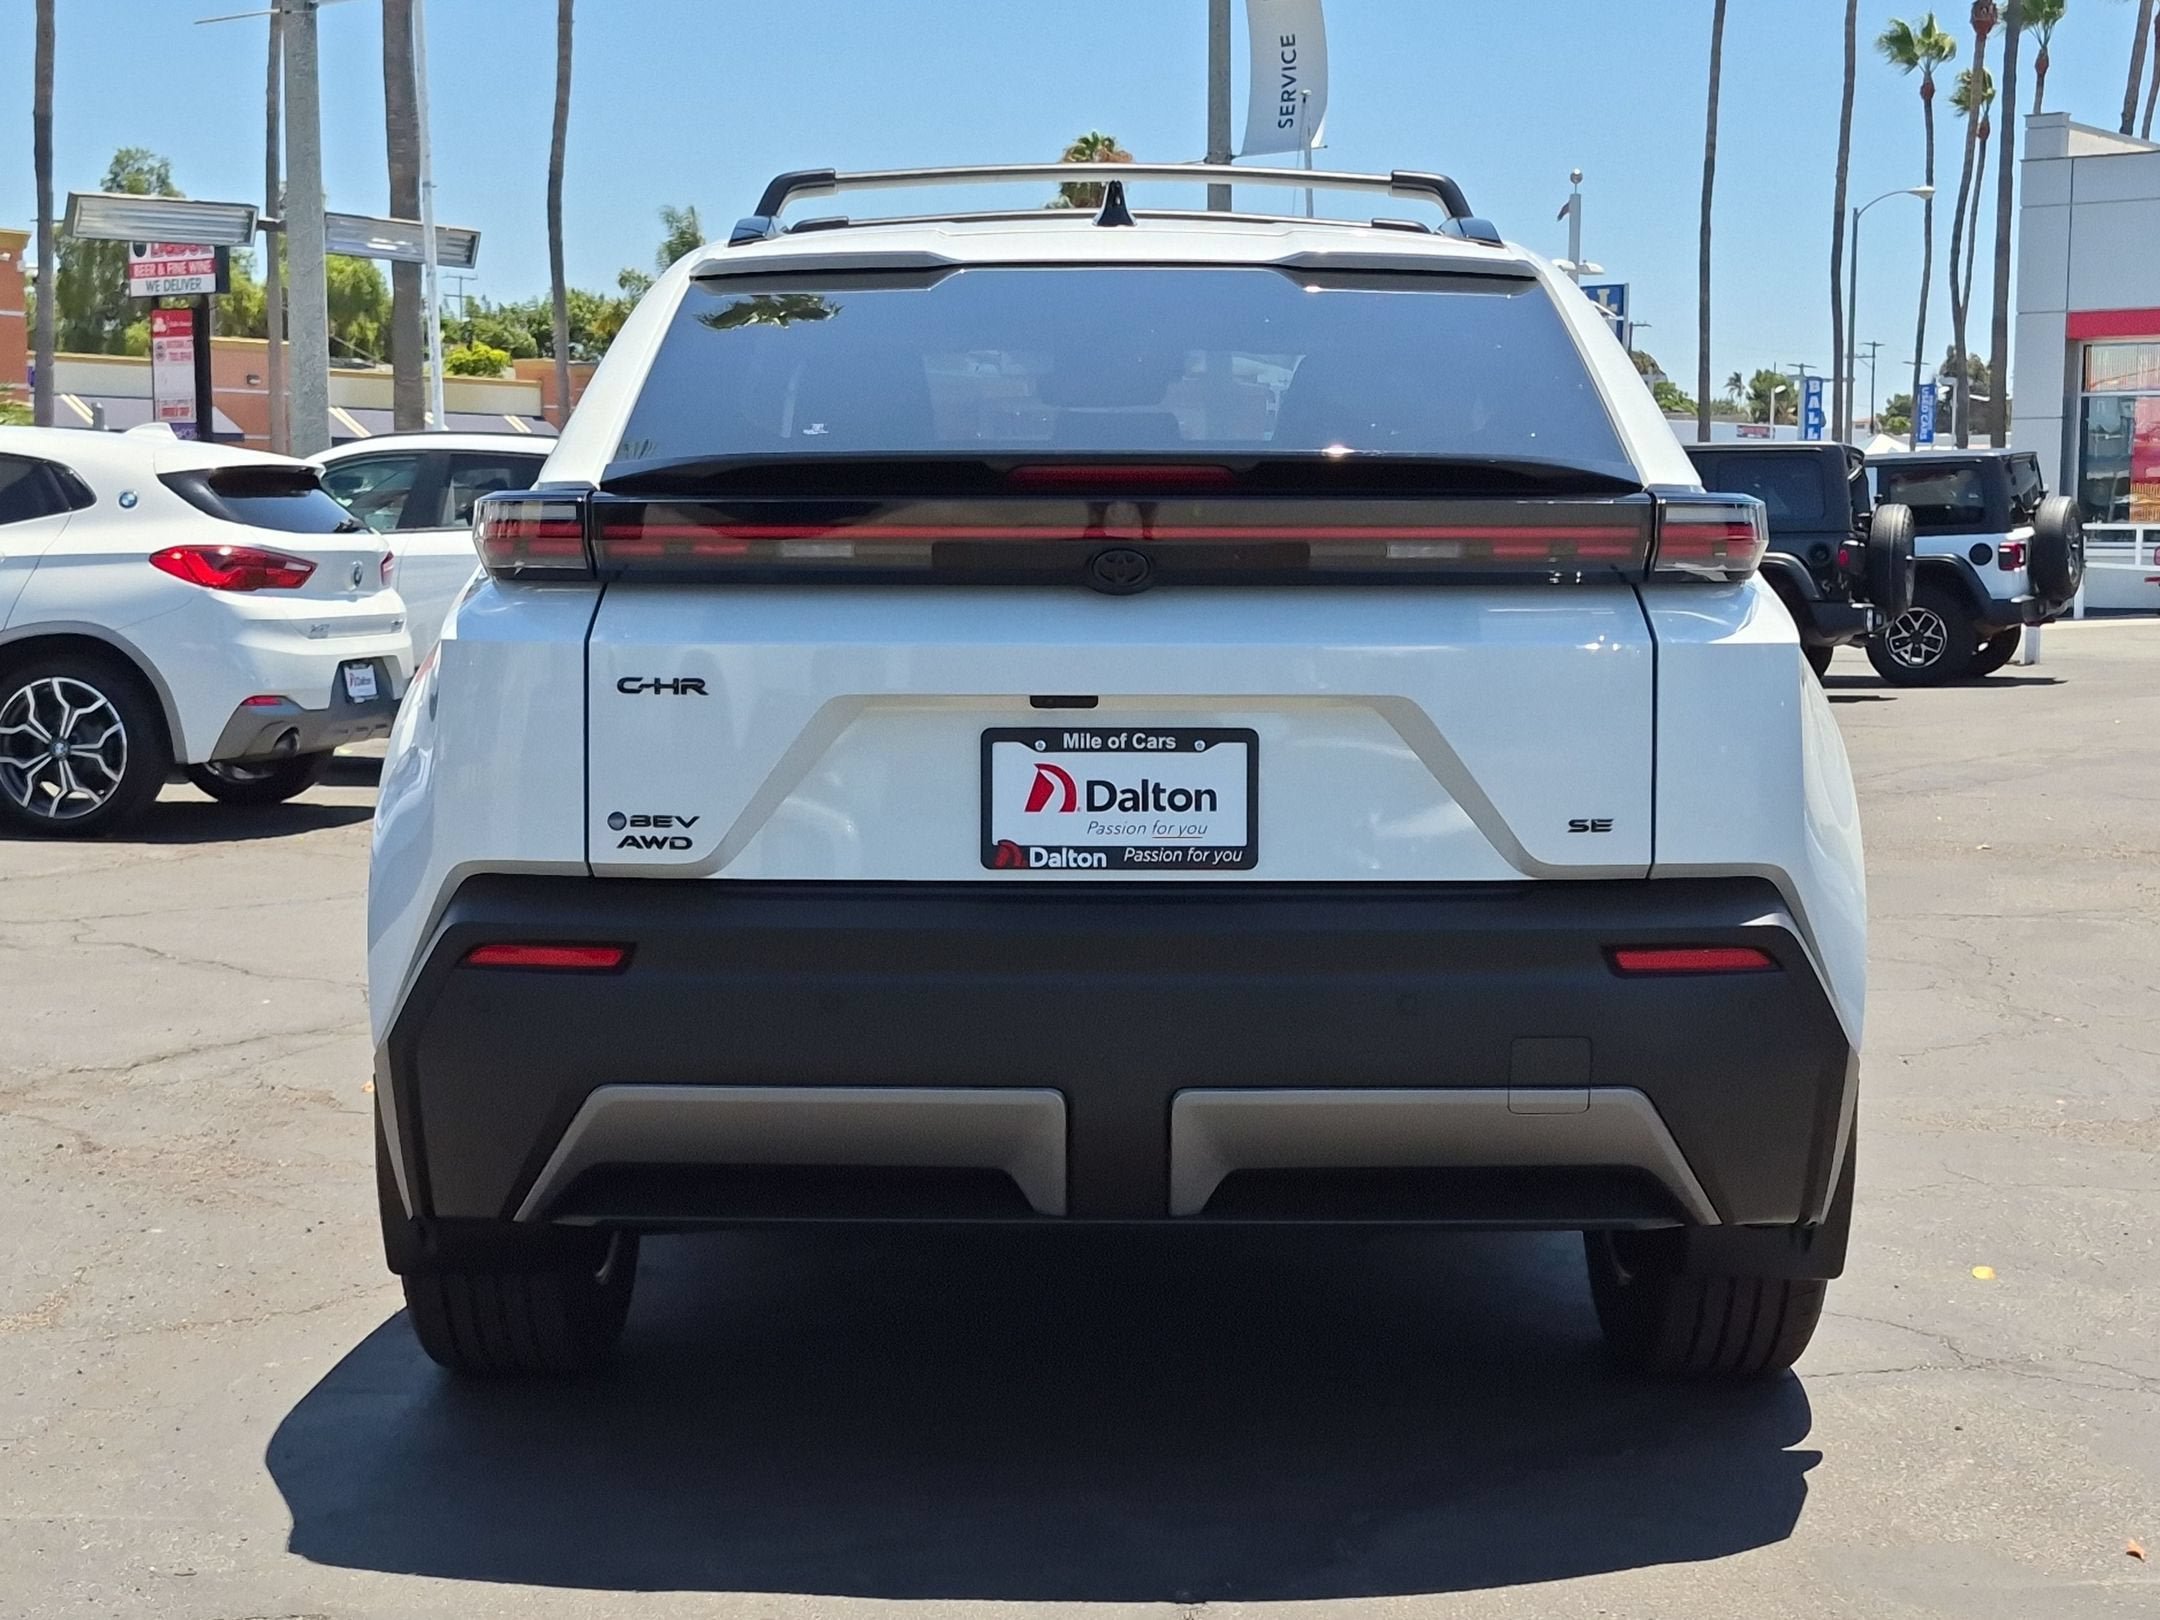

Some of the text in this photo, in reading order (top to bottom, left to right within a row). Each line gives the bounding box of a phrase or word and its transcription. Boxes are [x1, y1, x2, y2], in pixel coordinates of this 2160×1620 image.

[1278, 33, 1297, 129] SERVICE
[145, 277, 202, 293] WE DELIVER
[1807, 380, 1821, 440] BALL
[616, 676, 710, 695] C-HR
[1063, 732, 1177, 749] Mile of Cars
[1086, 778, 1217, 813] Dalton
[629, 813, 701, 829] BEV
[1086, 819, 1208, 837] Passion for you
[1567, 818, 1614, 833] SE
[616, 835, 693, 850] AWD
[1029, 846, 1107, 868] Dalton
[1123, 847, 1243, 865] Passion for you
